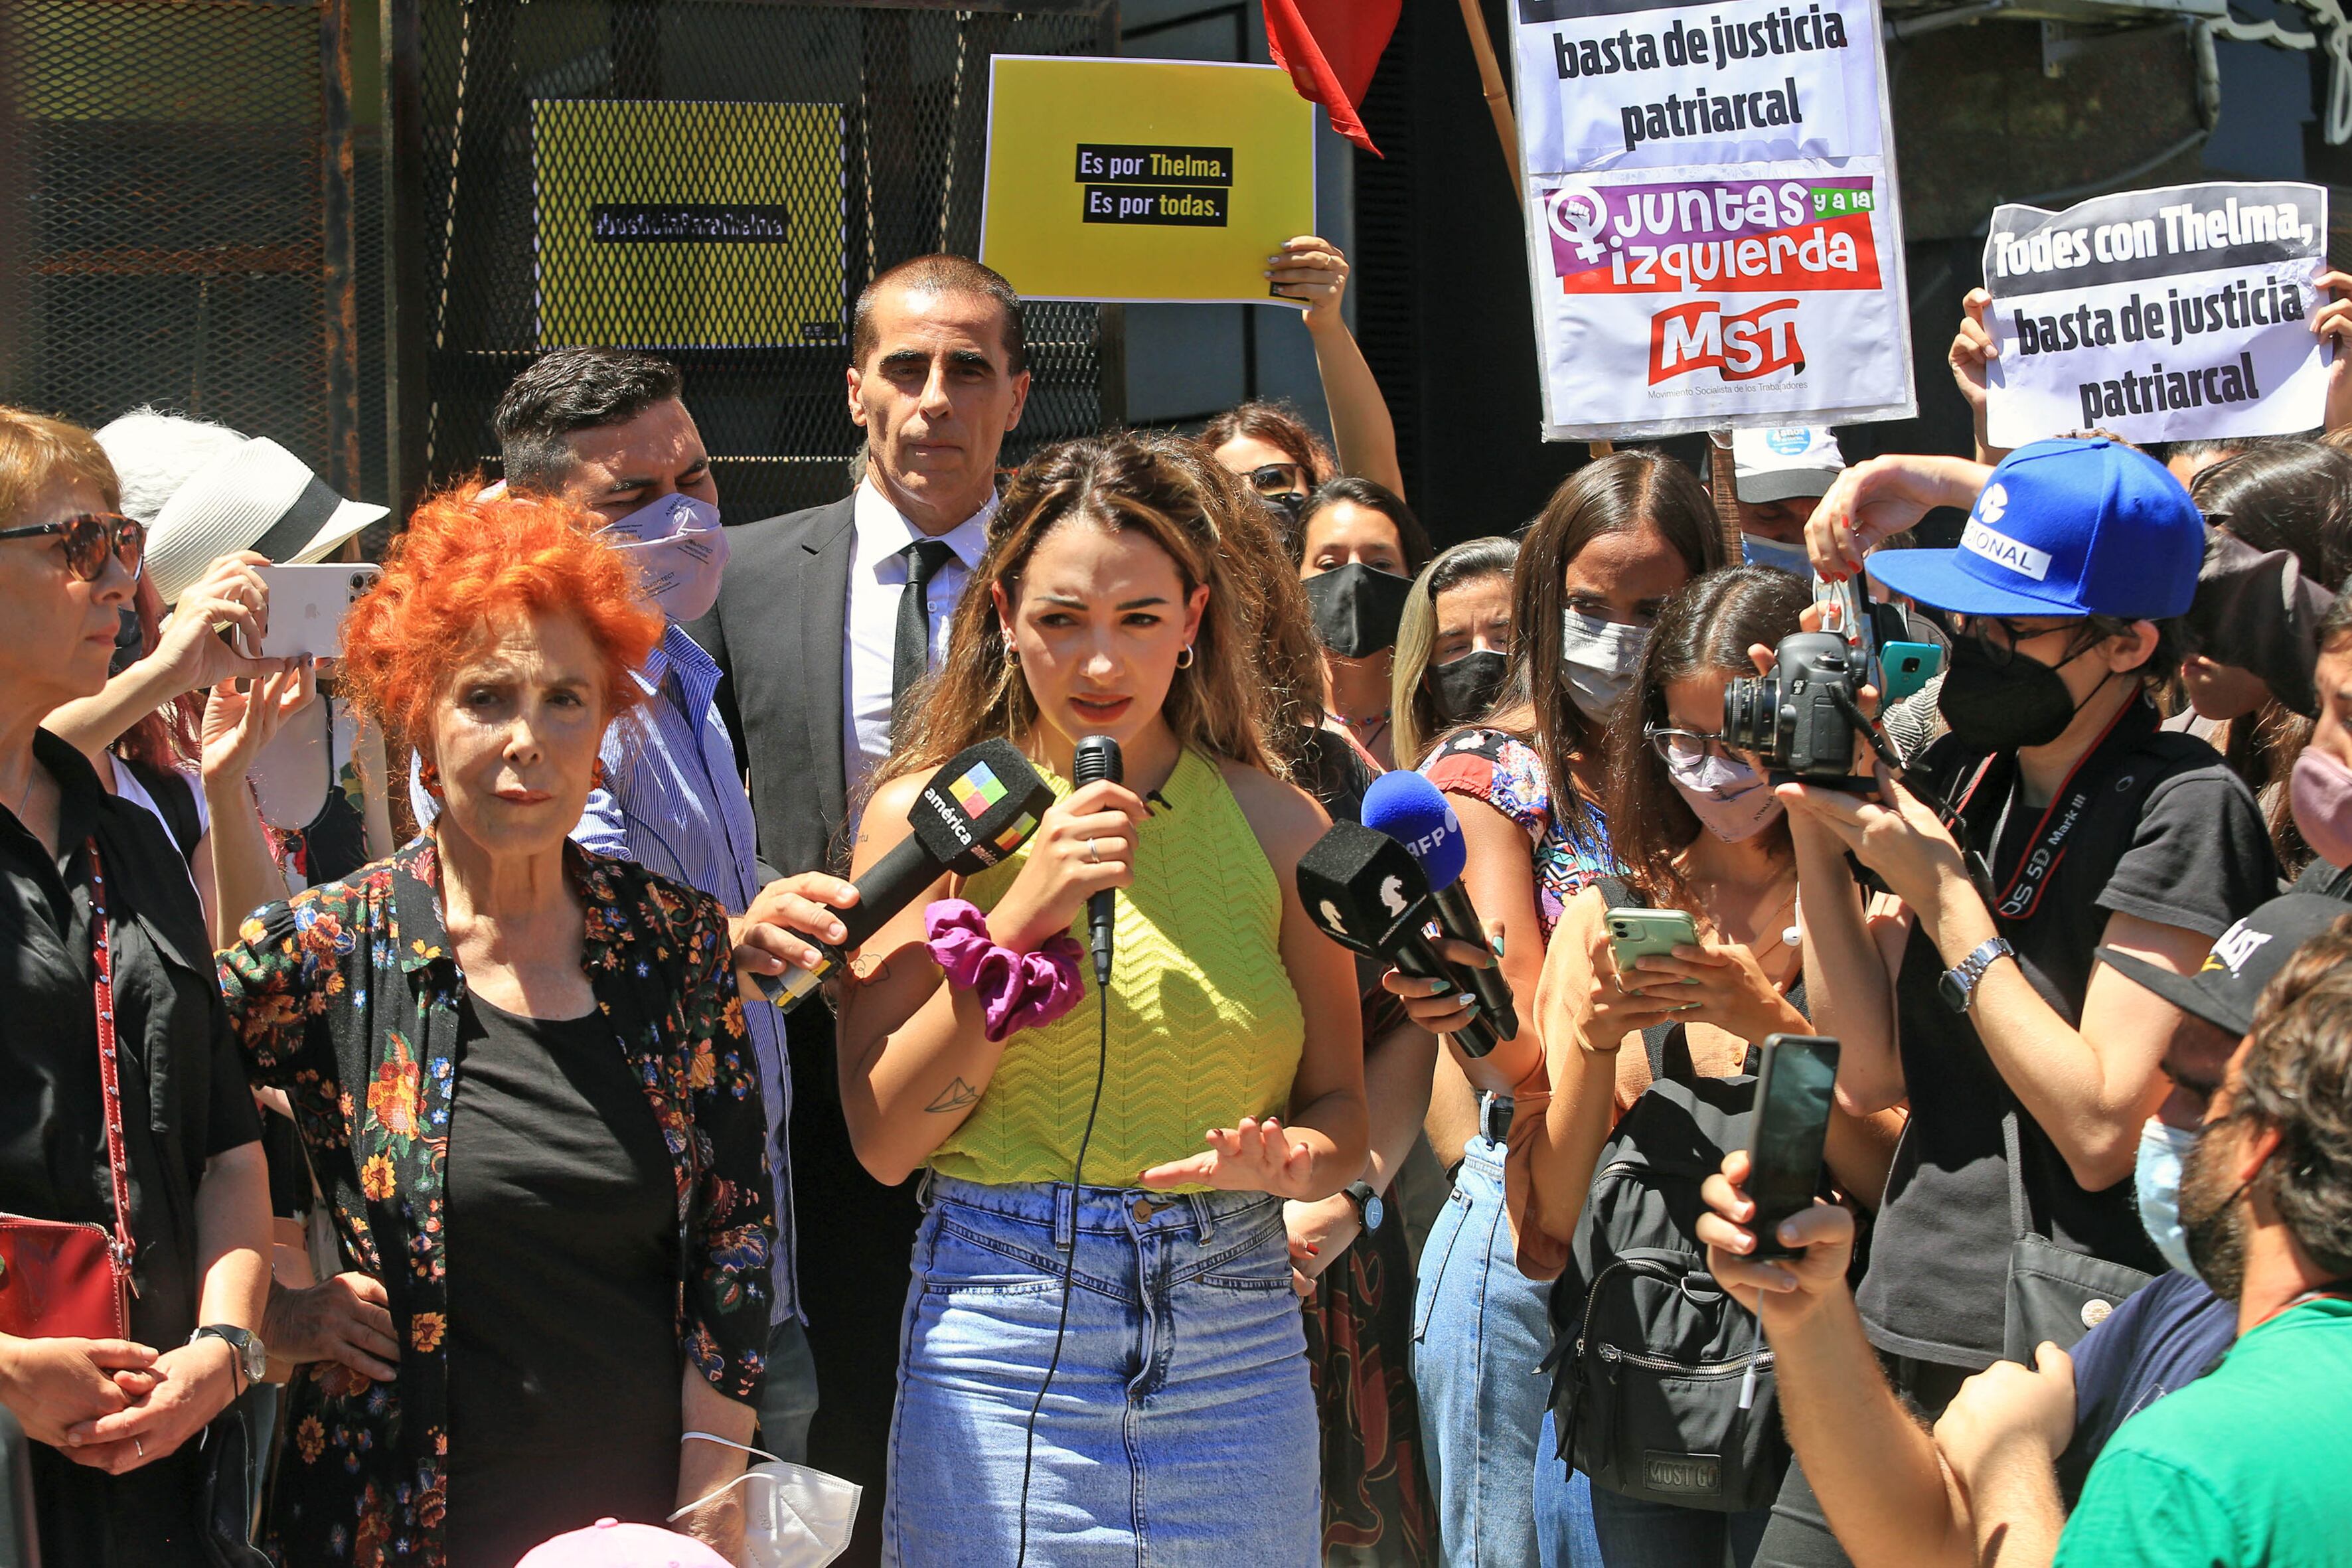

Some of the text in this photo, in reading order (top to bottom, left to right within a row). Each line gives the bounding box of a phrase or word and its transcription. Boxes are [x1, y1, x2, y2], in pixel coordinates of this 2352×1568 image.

[1553, 4, 1847, 80] basta de justicia
[1620, 77, 1802, 151] patriarcal
[1080, 151, 1227, 179] Es por Thelma.
[1090, 191, 1221, 219] Es por todas.
[1813, 195, 1826, 212] y
[1831, 193, 1845, 211] a
[1994, 197, 2314, 277] Todes con Thelma,
[1661, 309, 1800, 374] MST
[2015, 275, 2306, 356] basta de justicia
[1648, 388, 1693, 400] Movimiento
[1695, 385, 1733, 396] Socialista
[1745, 384, 1757, 392] los
[1758, 381, 1808, 394] Trabajadores
[2080, 353, 2259, 430] patriarcal
[924, 787, 973, 846] américa
[1405, 826, 1446, 858] AFP
[2027, 848, 2051, 880] 5D
[2047, 809, 2079, 846] Mark
[2072, 793, 2087, 809] III
[1648, 1460, 1717, 1488] MUST GO
